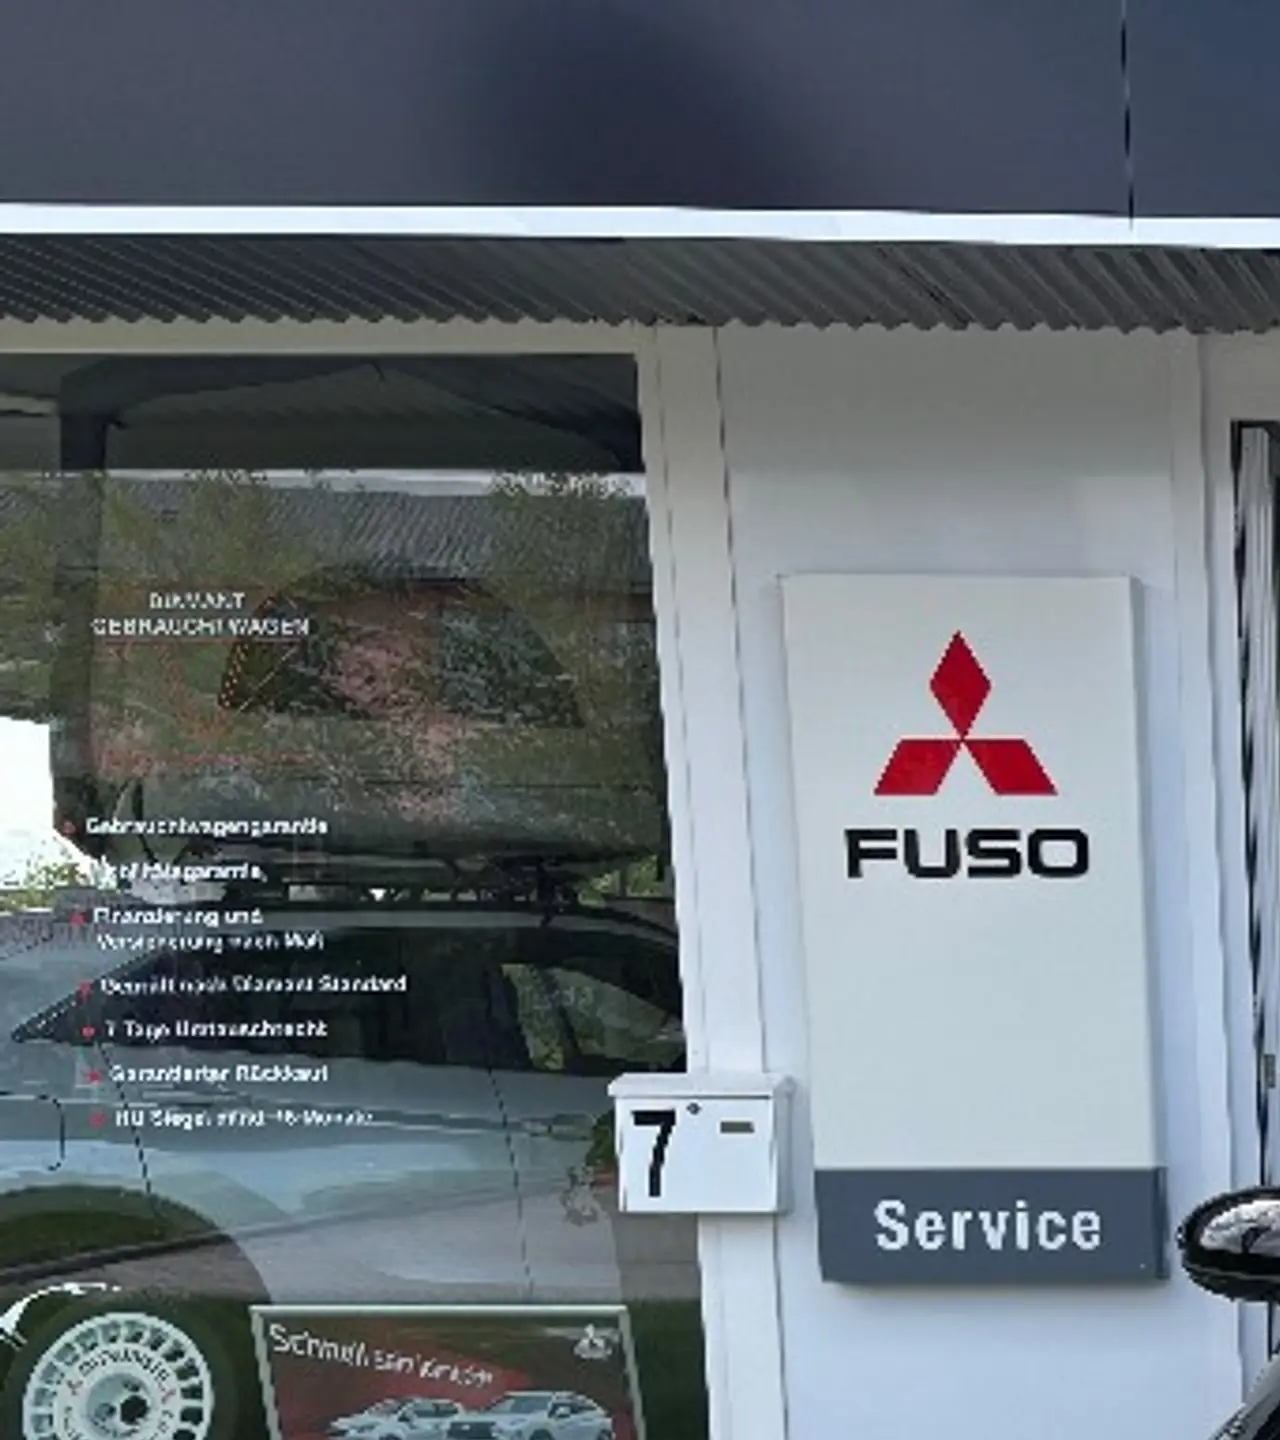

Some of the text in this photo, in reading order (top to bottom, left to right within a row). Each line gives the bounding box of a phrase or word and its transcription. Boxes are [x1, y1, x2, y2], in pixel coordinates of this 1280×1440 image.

[844, 828, 1090, 879] FUSO
[631, 1109, 677, 1198] 7
[874, 1200, 1101, 1251] Service
